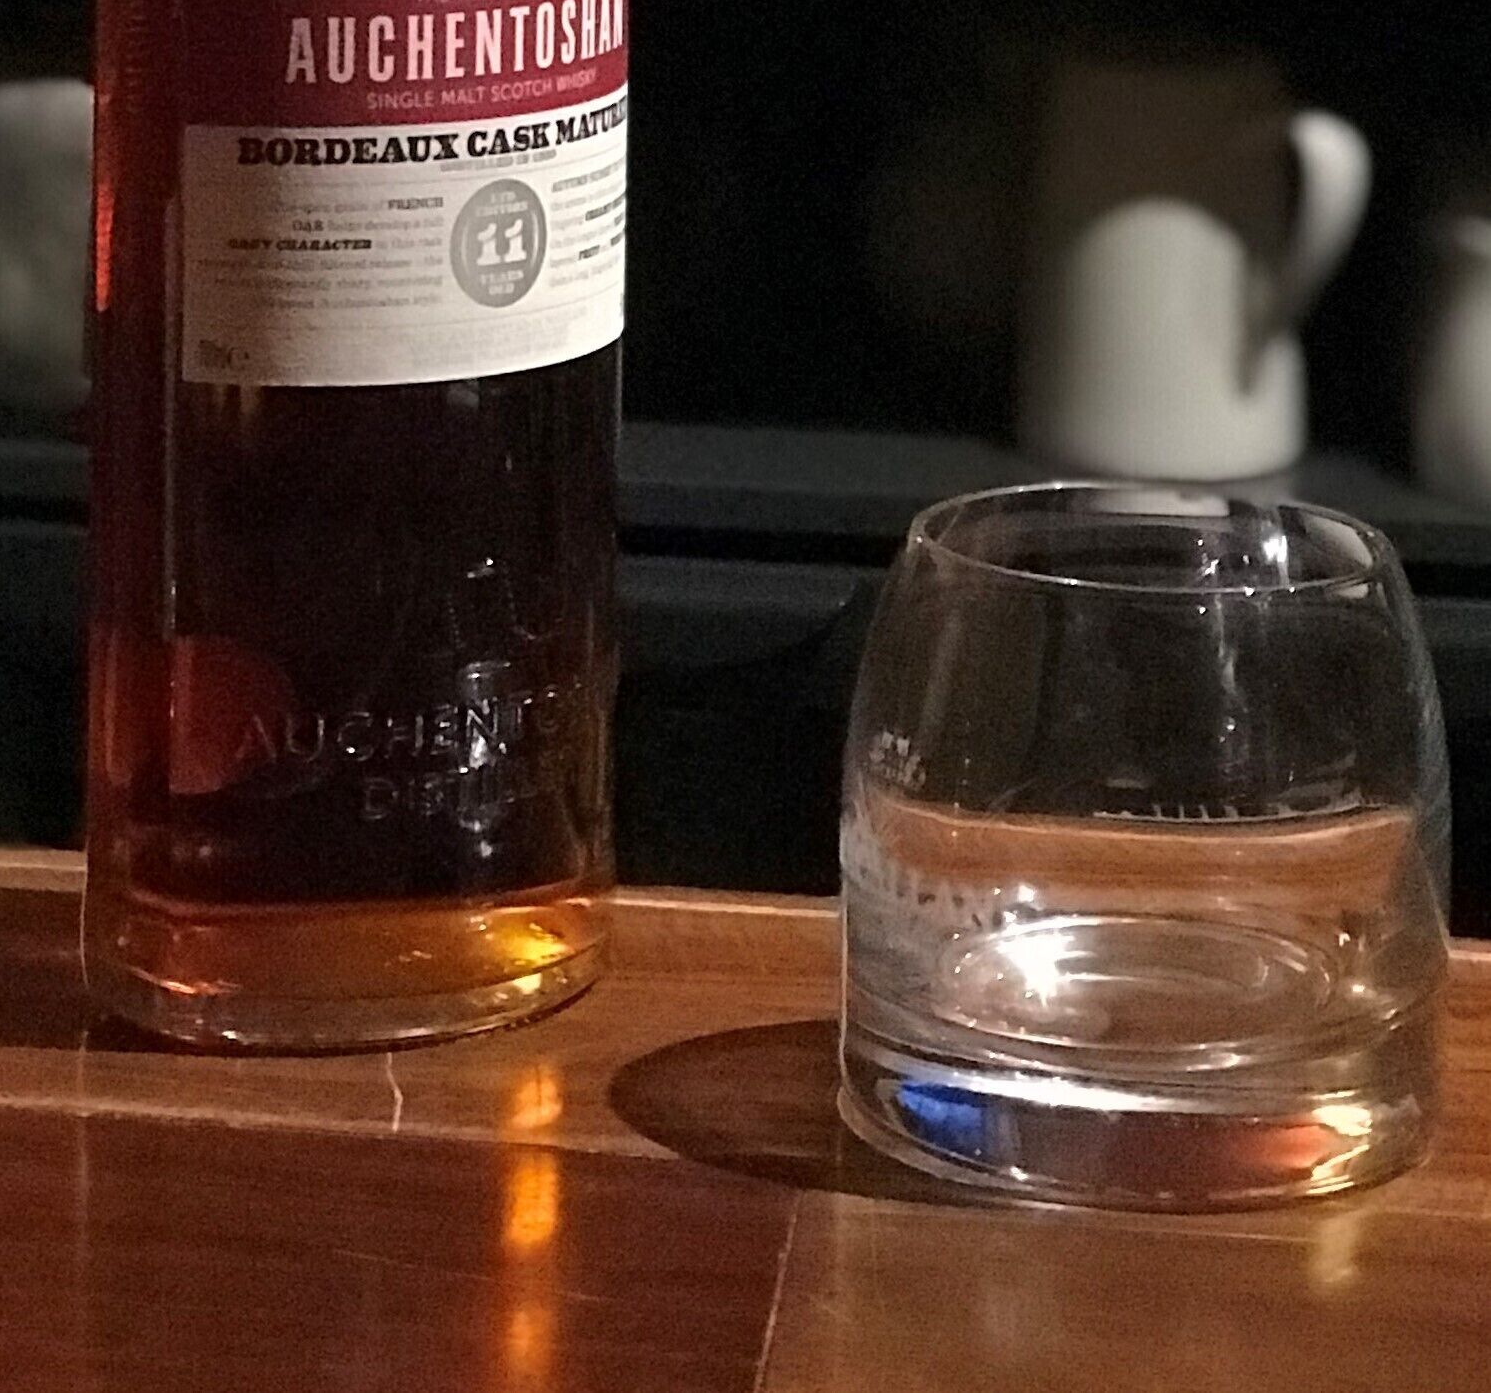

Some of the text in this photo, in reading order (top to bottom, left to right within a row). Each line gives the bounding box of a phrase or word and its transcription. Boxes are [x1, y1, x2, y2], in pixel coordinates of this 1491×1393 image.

[367, 67, 597, 110] SINGLE MALT SCOTCH WHISKY
[237, 134, 459, 167] BORDEAUX
[466, 122, 550, 158] CASK
[477, 218, 528, 267] 11
